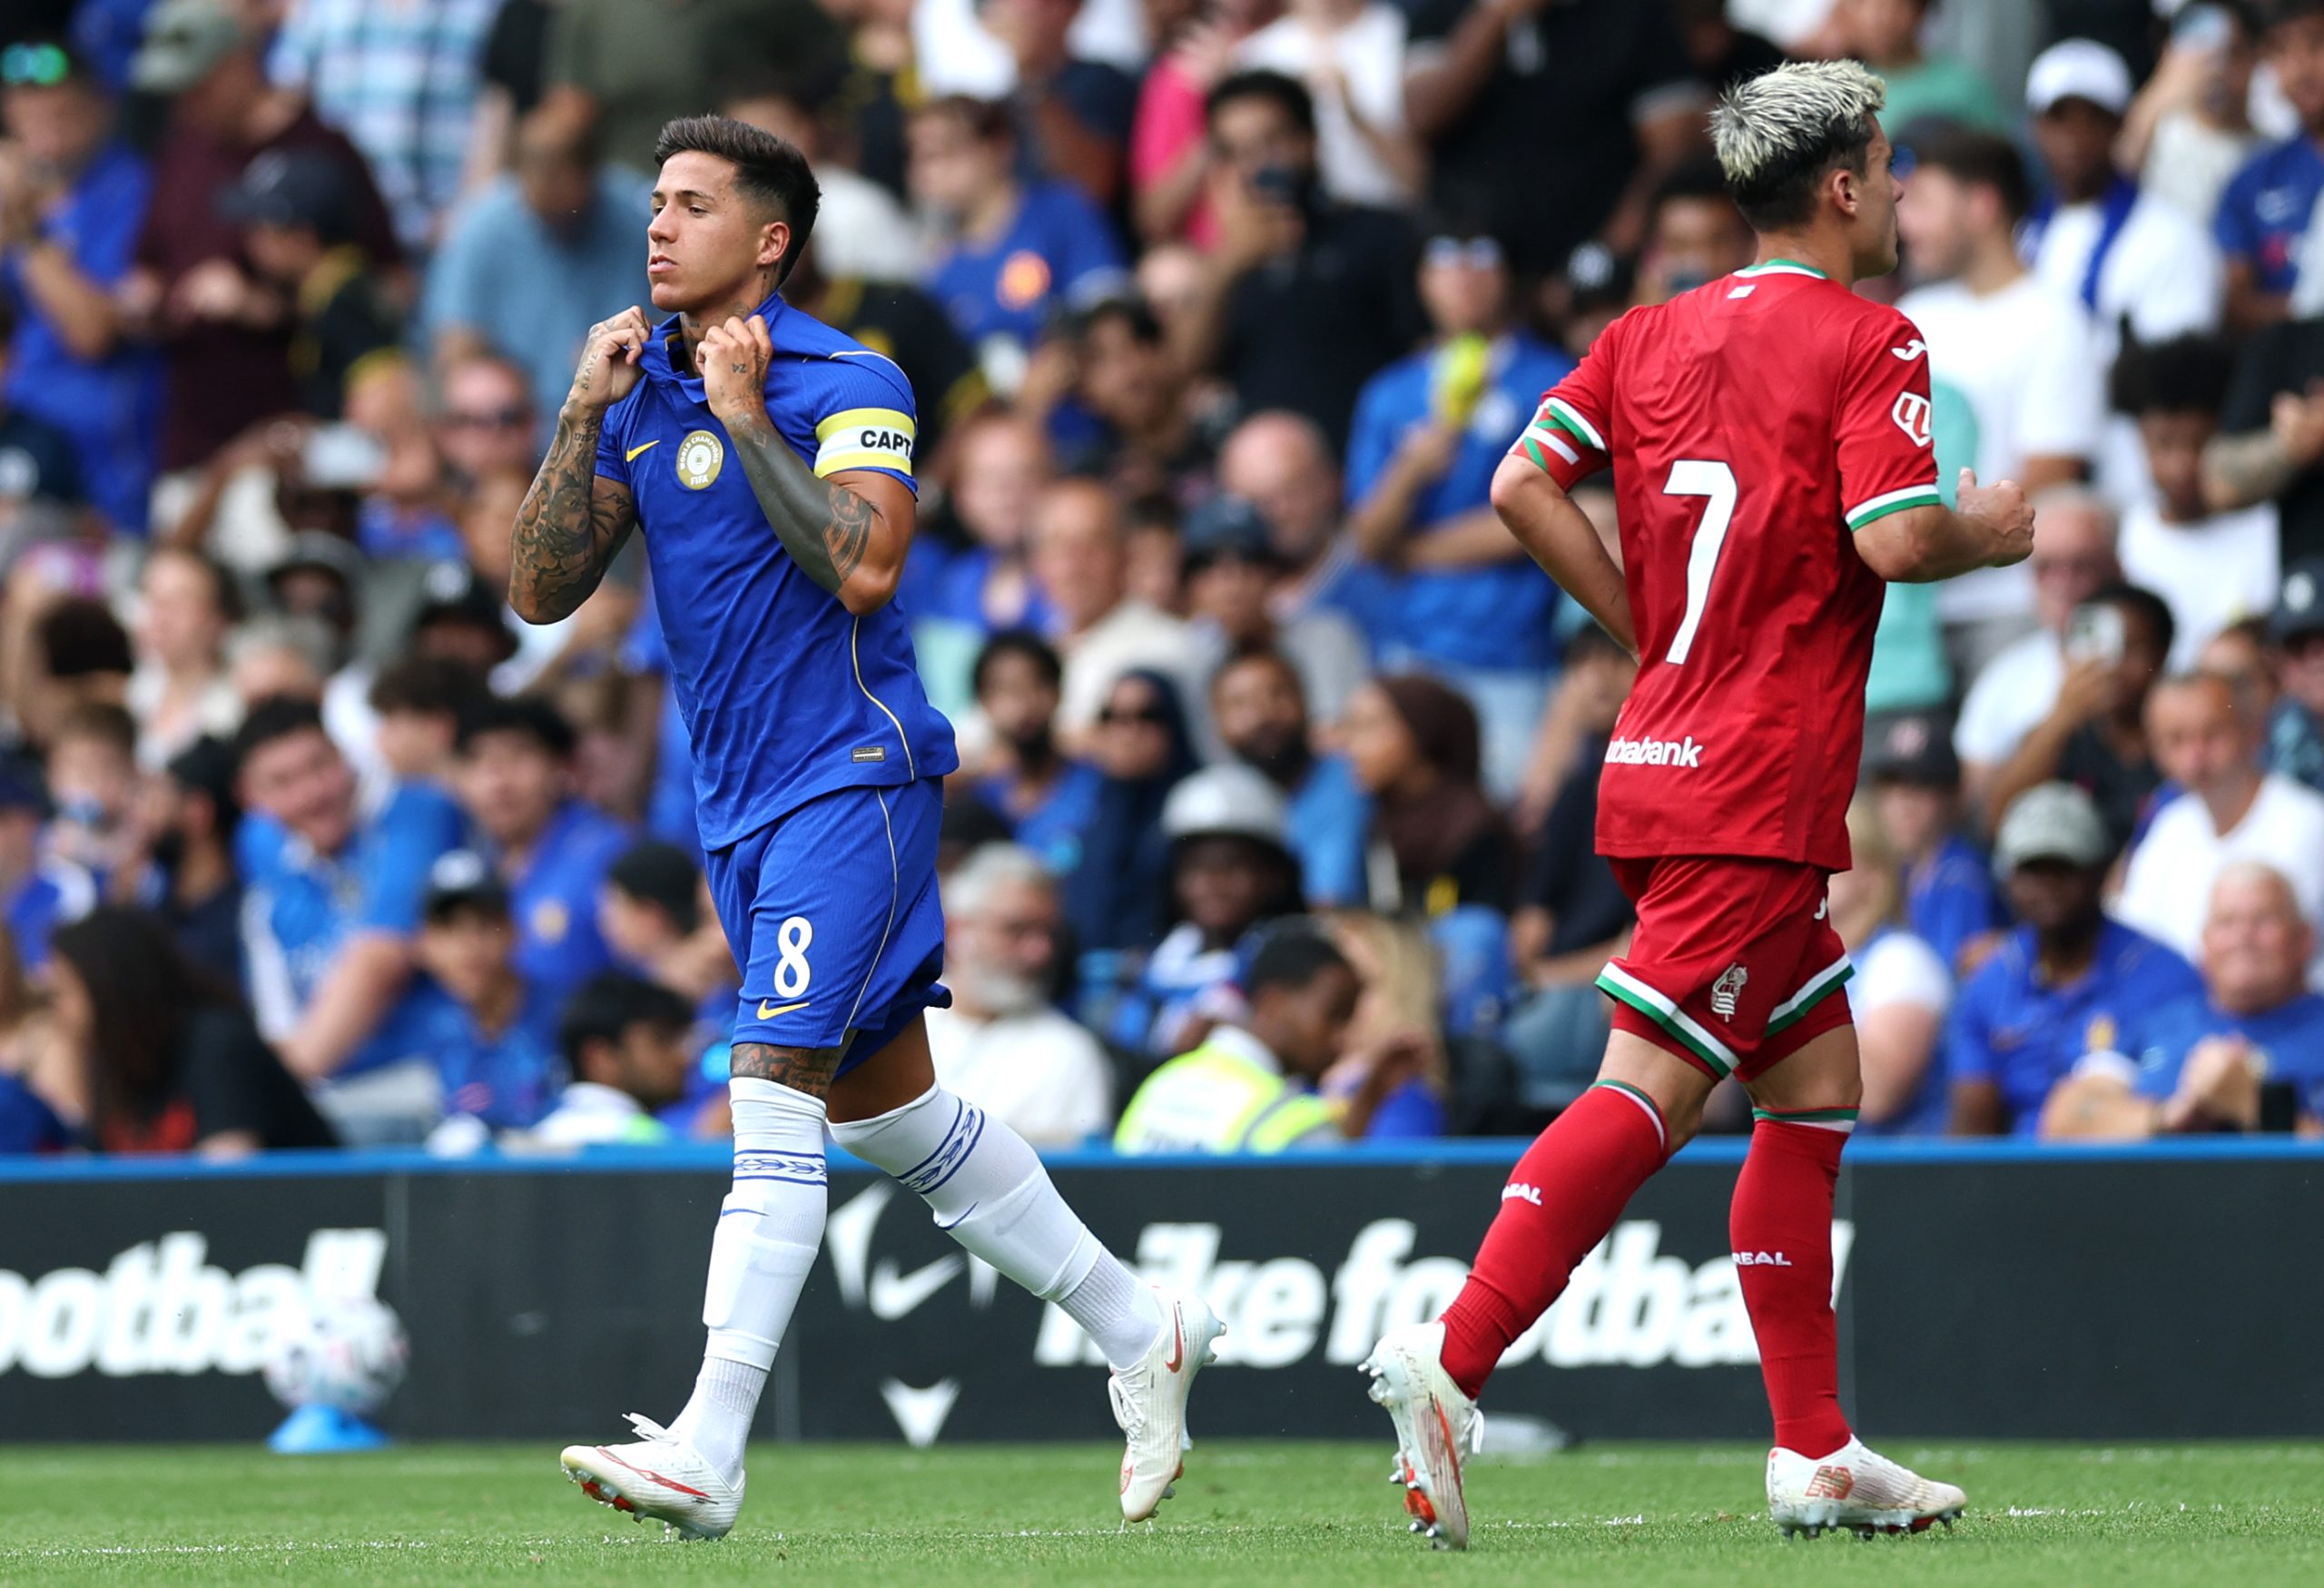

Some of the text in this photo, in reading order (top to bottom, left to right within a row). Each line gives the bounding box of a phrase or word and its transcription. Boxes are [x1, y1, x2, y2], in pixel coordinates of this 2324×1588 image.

[679, 435, 719, 470] WORLD CHAMPIONS
[860, 429, 911, 458] CAPT
[690, 474, 709, 486] FIFA
[1662, 459, 1738, 665] 7
[773, 916, 812, 999] 8
[1731, 1250, 1793, 1267] REAL
[1324, 1218, 1856, 1369] fotba
